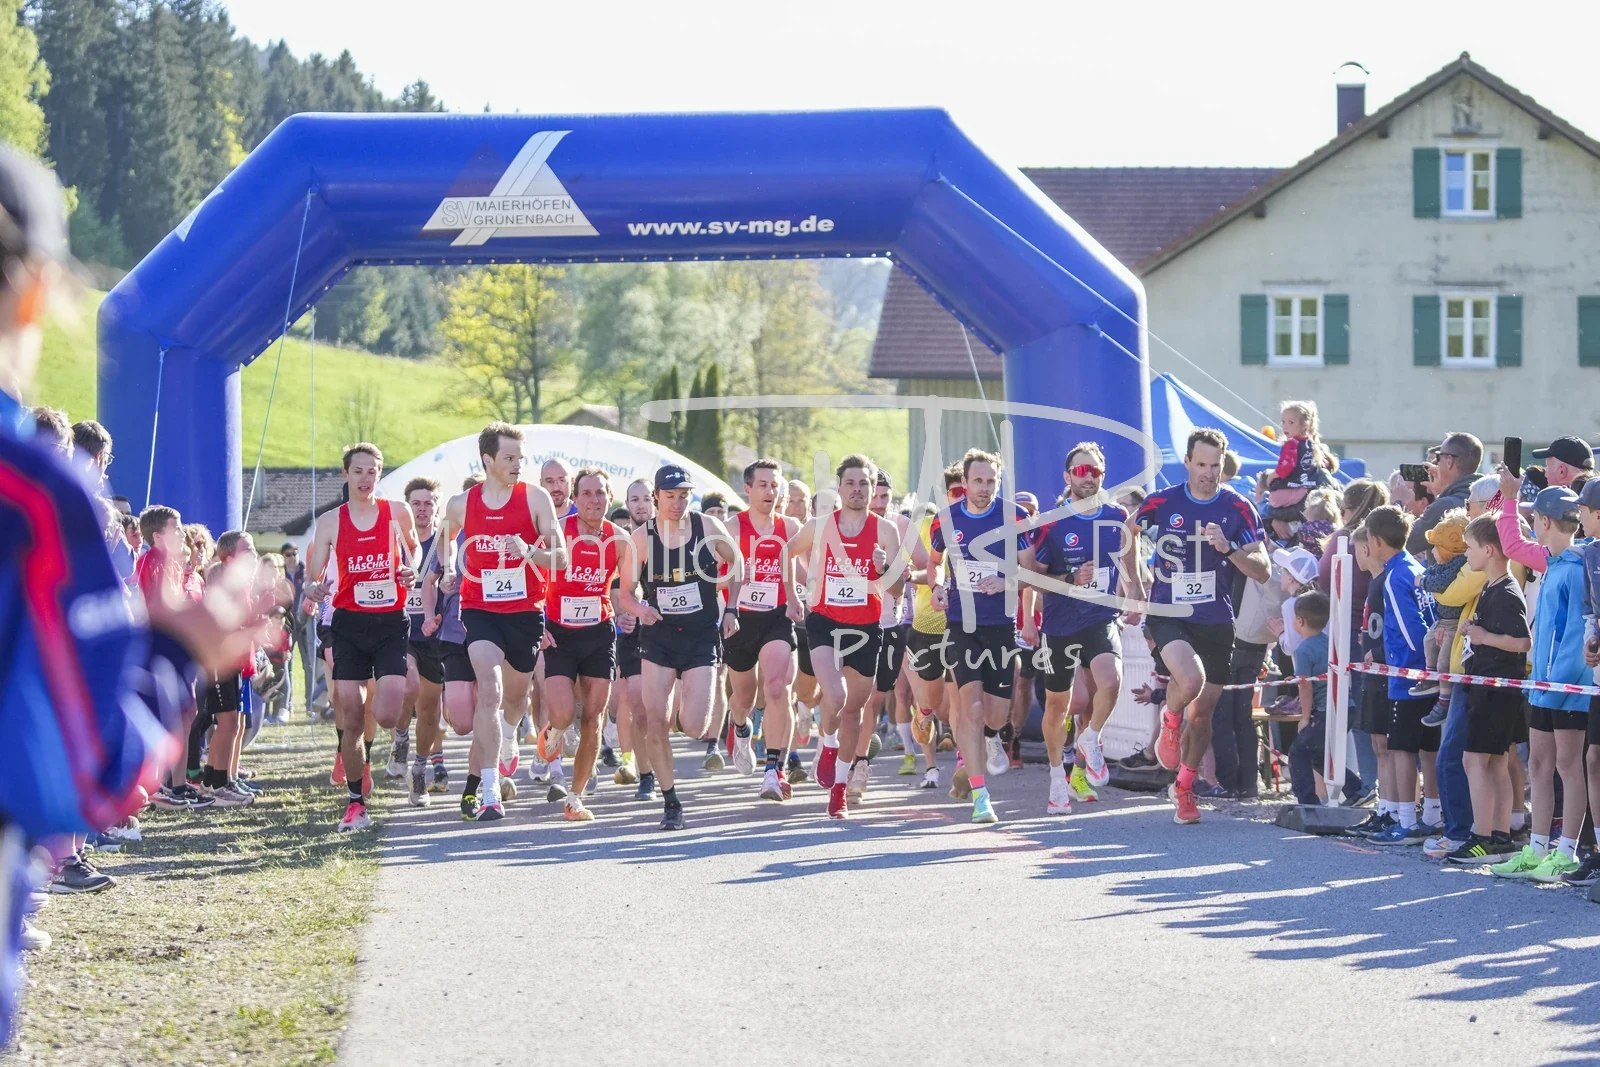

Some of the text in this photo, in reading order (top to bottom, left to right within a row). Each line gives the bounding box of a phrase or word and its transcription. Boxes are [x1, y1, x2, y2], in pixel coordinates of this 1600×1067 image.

[442, 198, 571, 226] SV MAIERHÖFEN
[473, 213, 575, 226] GRÜNENBACH
[627, 214, 836, 237] www.sv-mg.de
[348, 559, 391, 571] HASCHKO
[746, 557, 779, 566] SPOR
[827, 556, 871, 567] SPORT
[826, 563, 869, 573] HASCHKO
[495, 579, 512, 592] 24
[1186, 583, 1202, 595] 32
[368, 589, 384, 600] 38
[750, 591, 766, 602] 67
[838, 587, 854, 598] 42
[407, 596, 422, 607] 43
[670, 595, 688, 608] 28
[574, 606, 589, 618] 77
